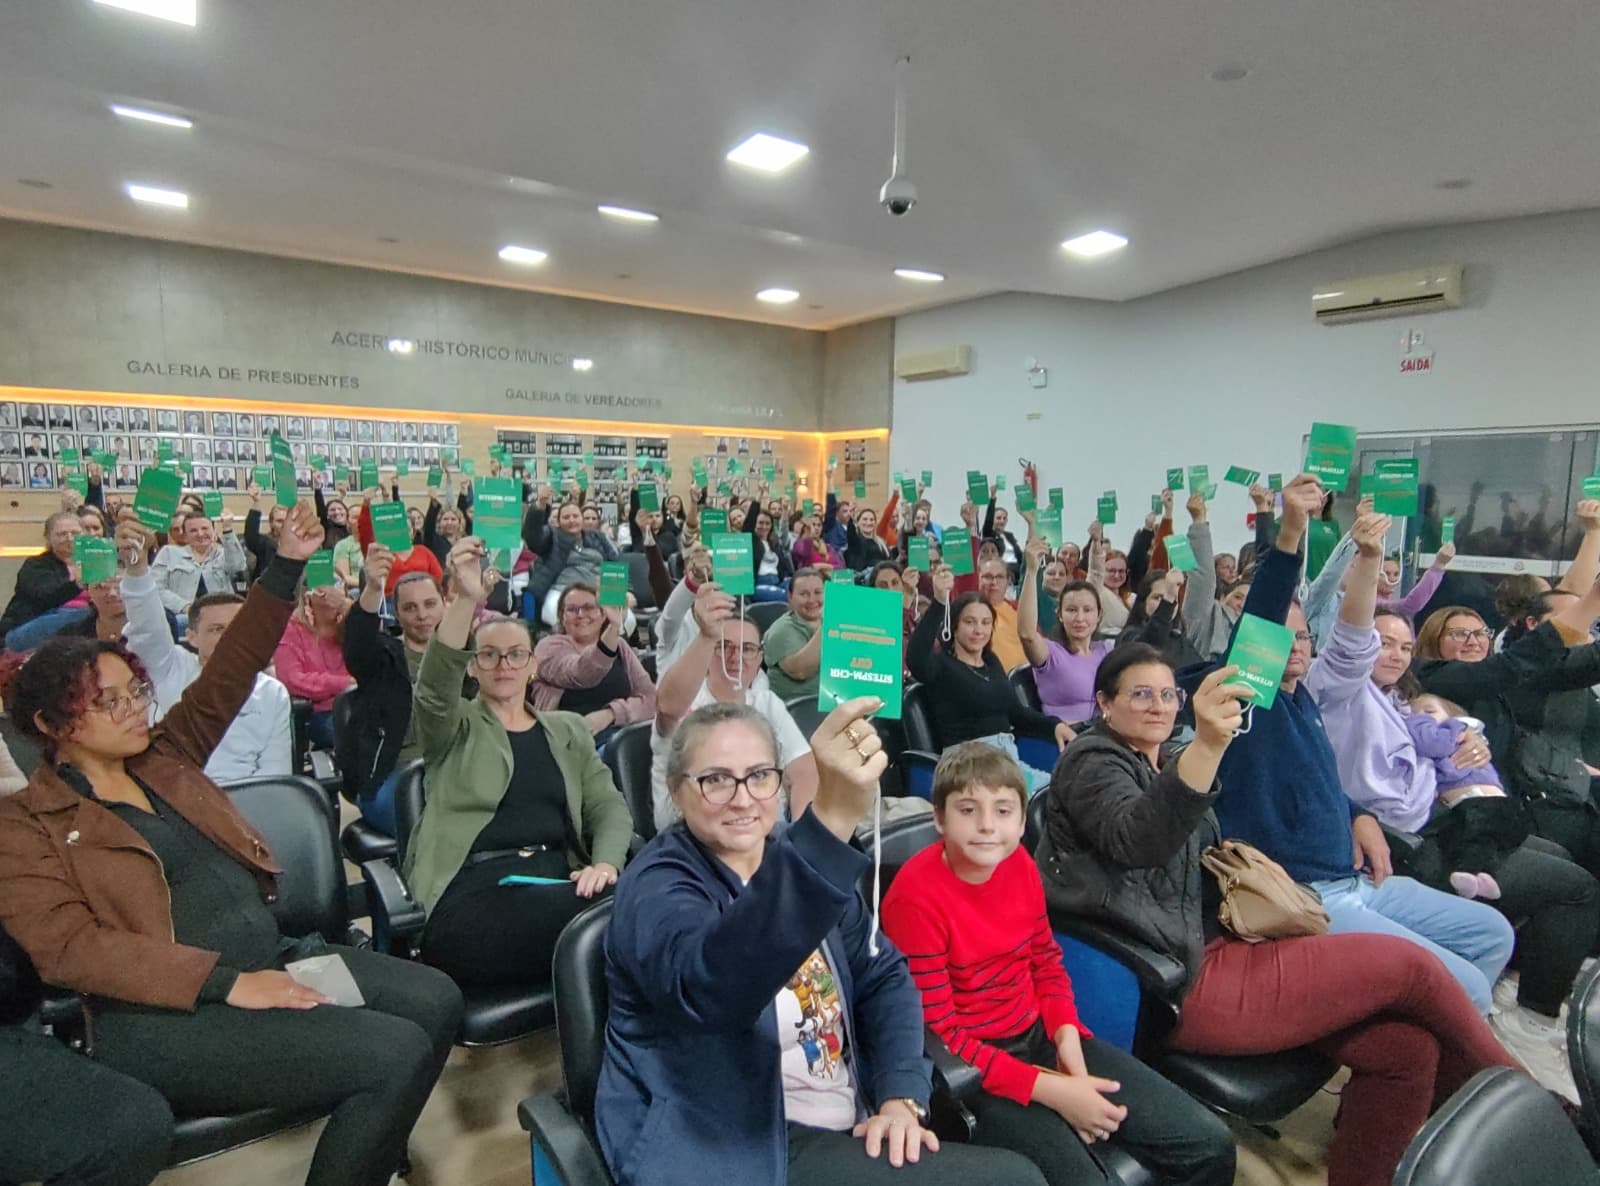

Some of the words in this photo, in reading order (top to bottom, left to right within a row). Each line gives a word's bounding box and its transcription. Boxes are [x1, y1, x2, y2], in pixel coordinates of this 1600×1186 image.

[331, 331, 412, 352] ACER
[127, 360, 212, 379] GALERIA
[218, 366, 241, 381] DE
[247, 369, 360, 389] PRESIDENTES
[505, 387, 561, 402] GALERIA
[584, 394, 663, 409] VEREADORES
